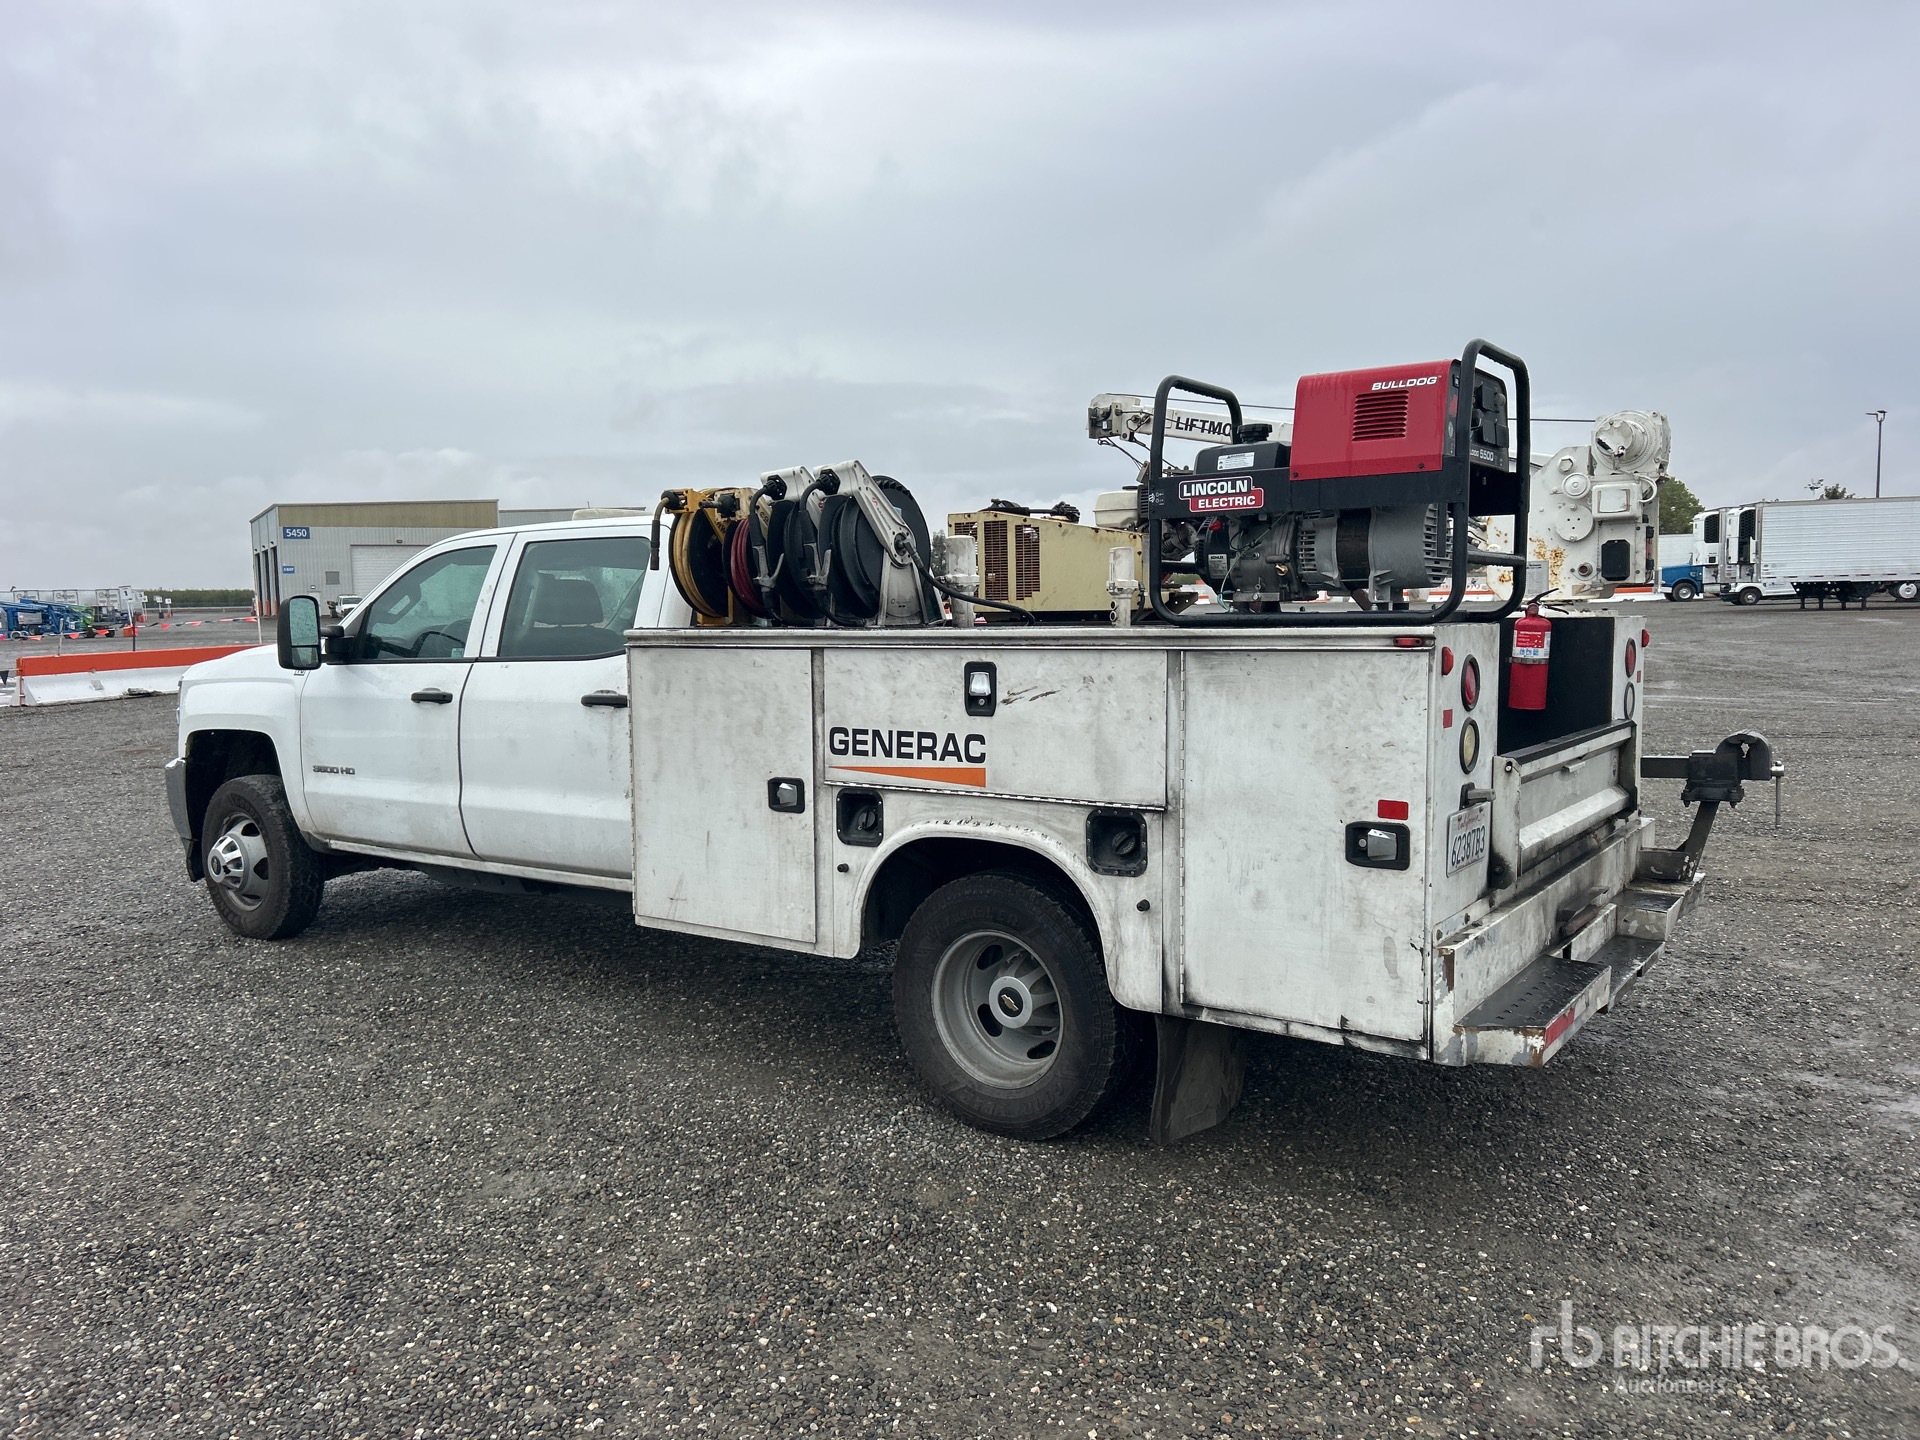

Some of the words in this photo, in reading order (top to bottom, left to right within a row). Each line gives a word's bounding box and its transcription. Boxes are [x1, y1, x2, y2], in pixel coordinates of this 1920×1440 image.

[1371, 376, 1437, 391] BULLDOG
[1479, 449, 1494, 462] 5500
[1183, 480, 1248, 497] LINCOLN
[1198, 495, 1256, 509] ELECTRIC
[286, 528, 307, 538] 5450
[829, 726, 987, 764] GENERAC
